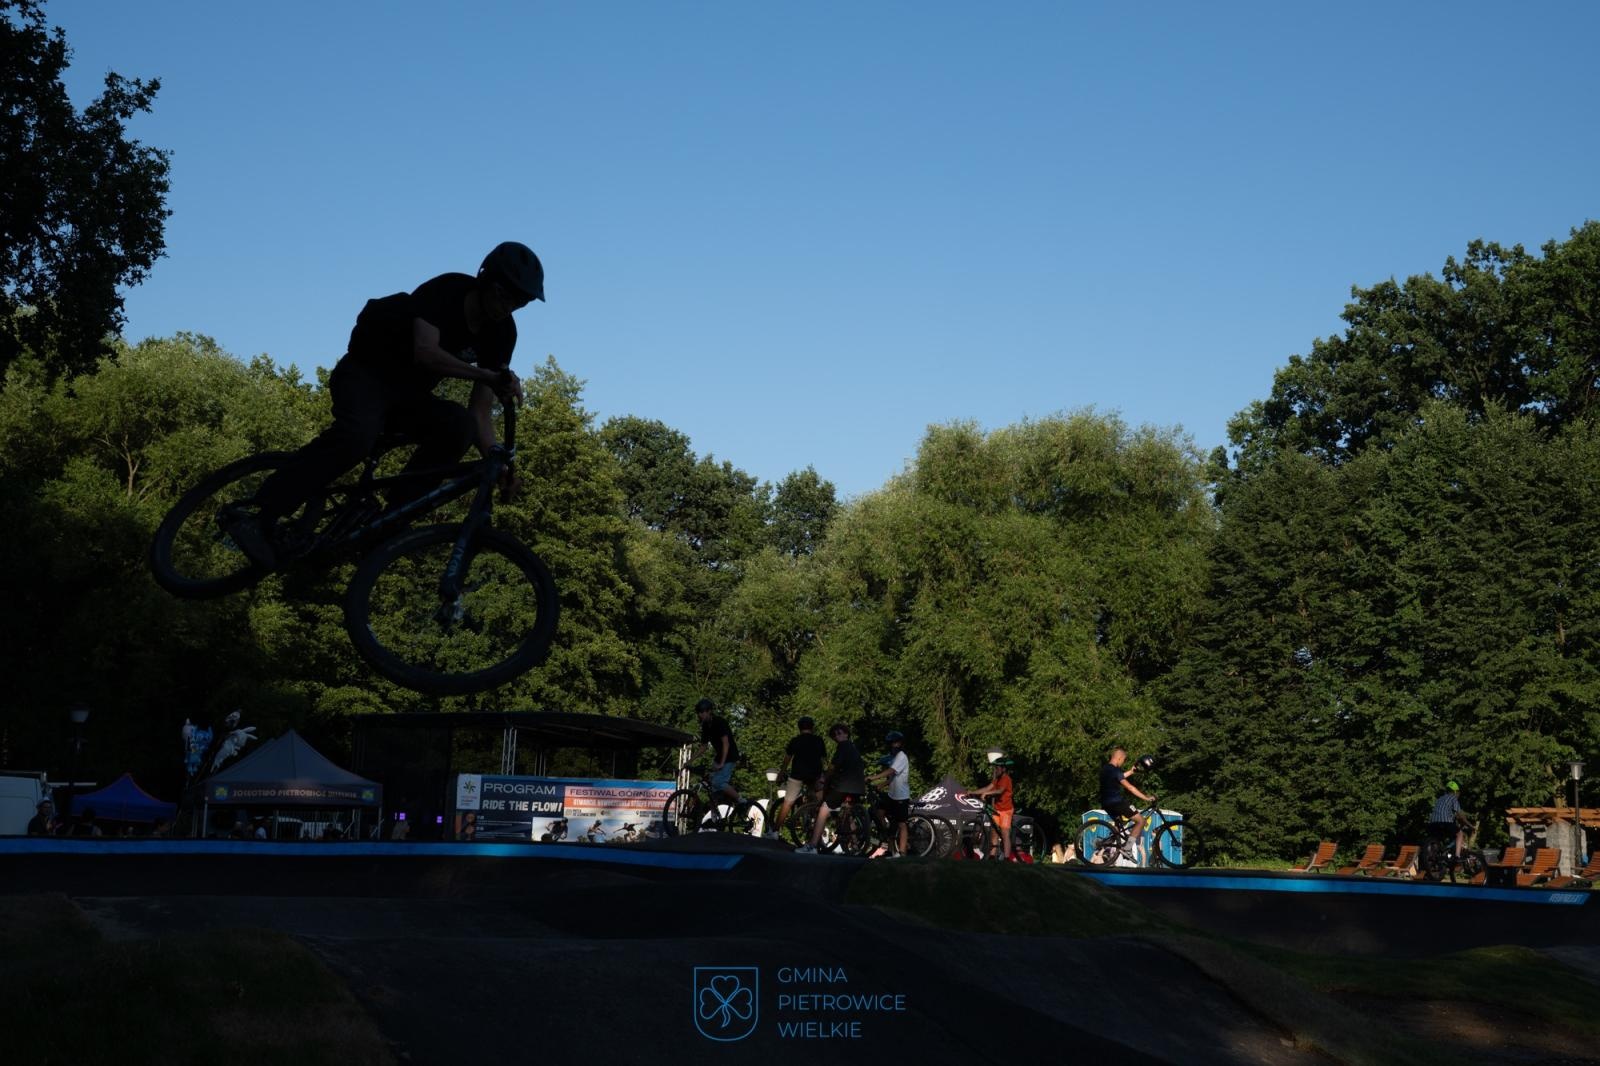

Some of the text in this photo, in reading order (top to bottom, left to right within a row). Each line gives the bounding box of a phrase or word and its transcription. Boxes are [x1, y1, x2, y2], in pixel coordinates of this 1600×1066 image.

[484, 783, 556, 795] PROGRAM
[570, 788, 617, 797] FESTIWAL
[482, 800, 505, 810] RIDE
[509, 800, 529, 811] THE
[531, 802, 563, 812] FLOW!
